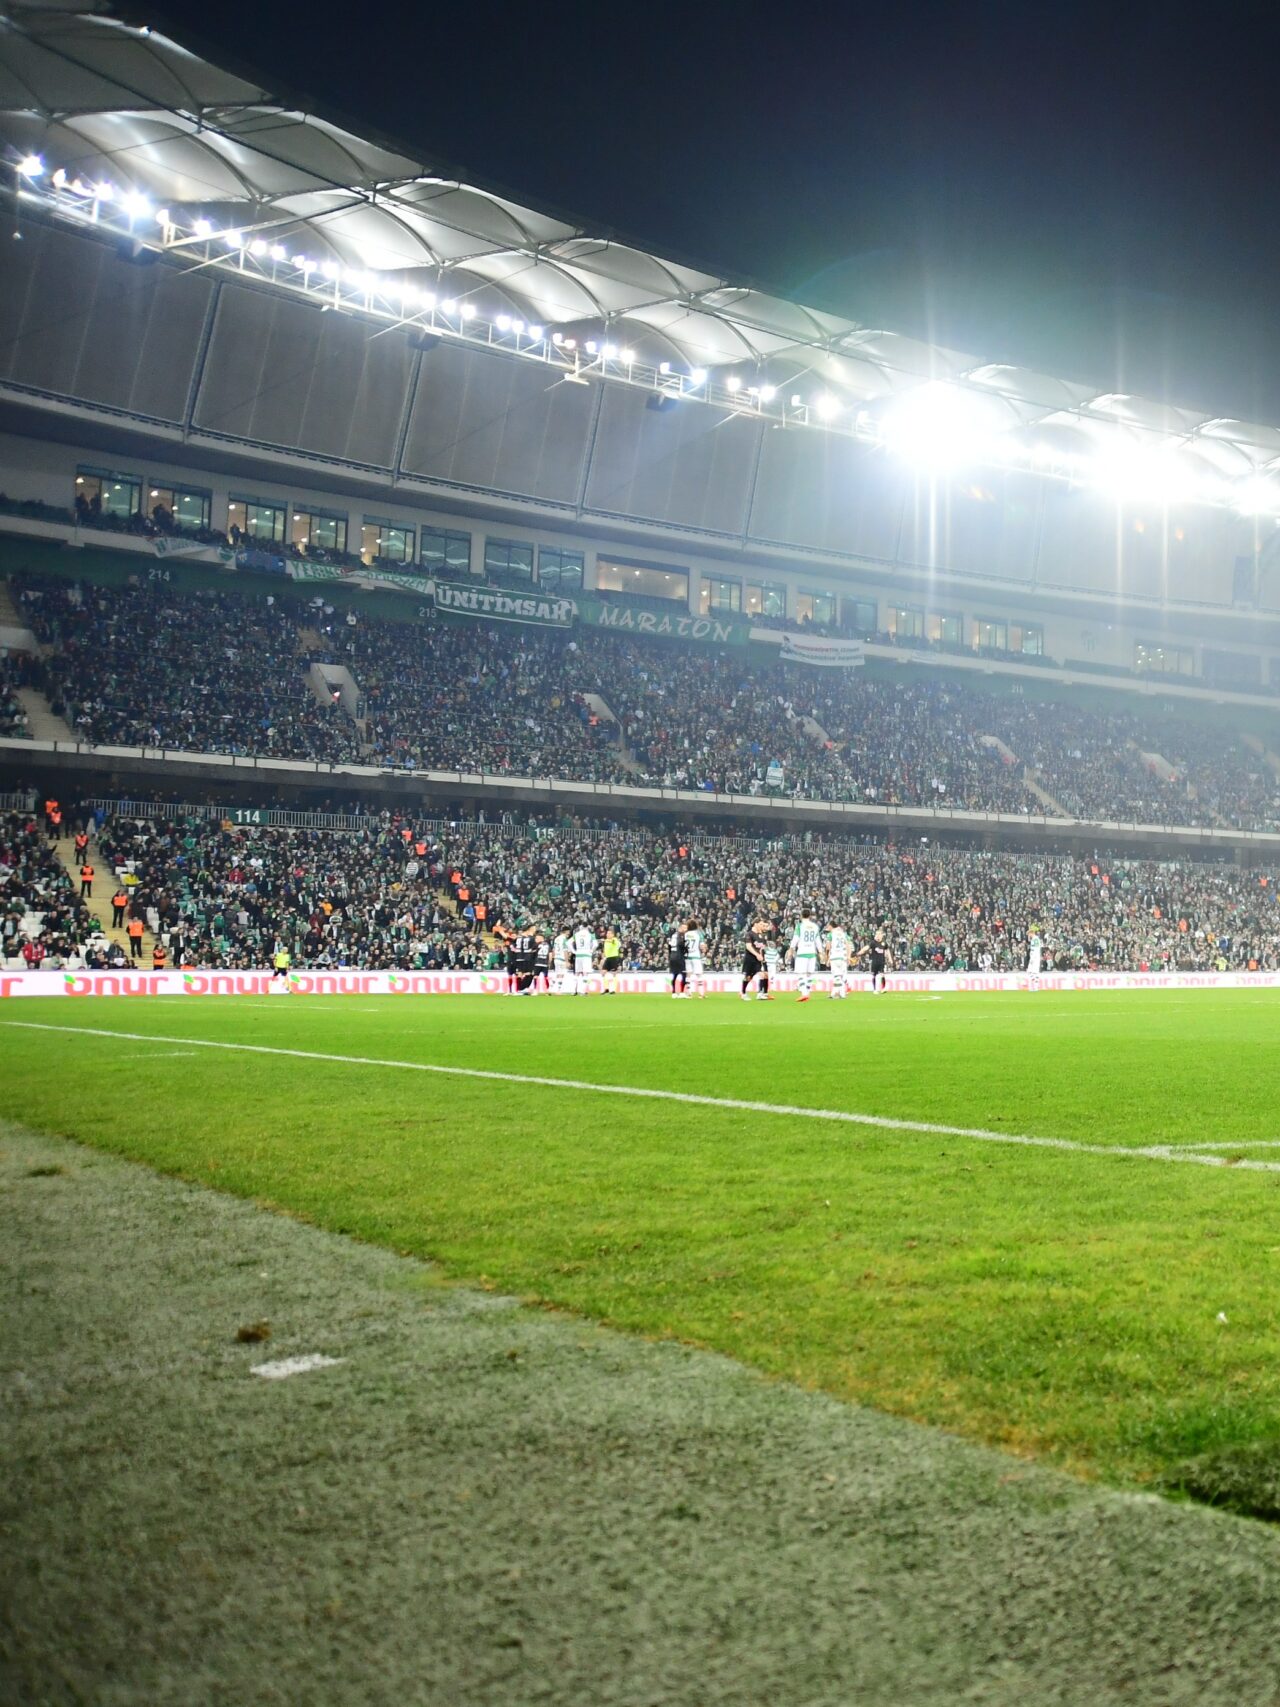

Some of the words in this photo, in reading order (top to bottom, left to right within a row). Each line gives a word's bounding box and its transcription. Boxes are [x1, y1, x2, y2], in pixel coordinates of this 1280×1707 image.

[149, 569, 170, 581] 214
[419, 607, 437, 618] 215
[599, 605, 732, 642] MARATON
[235, 810, 260, 823] 114
[535, 828, 554, 839] 115
[804, 931, 815, 942] 88
[64, 976, 168, 996] onur
[290, 976, 378, 994] onur
[388, 976, 469, 994] onur
